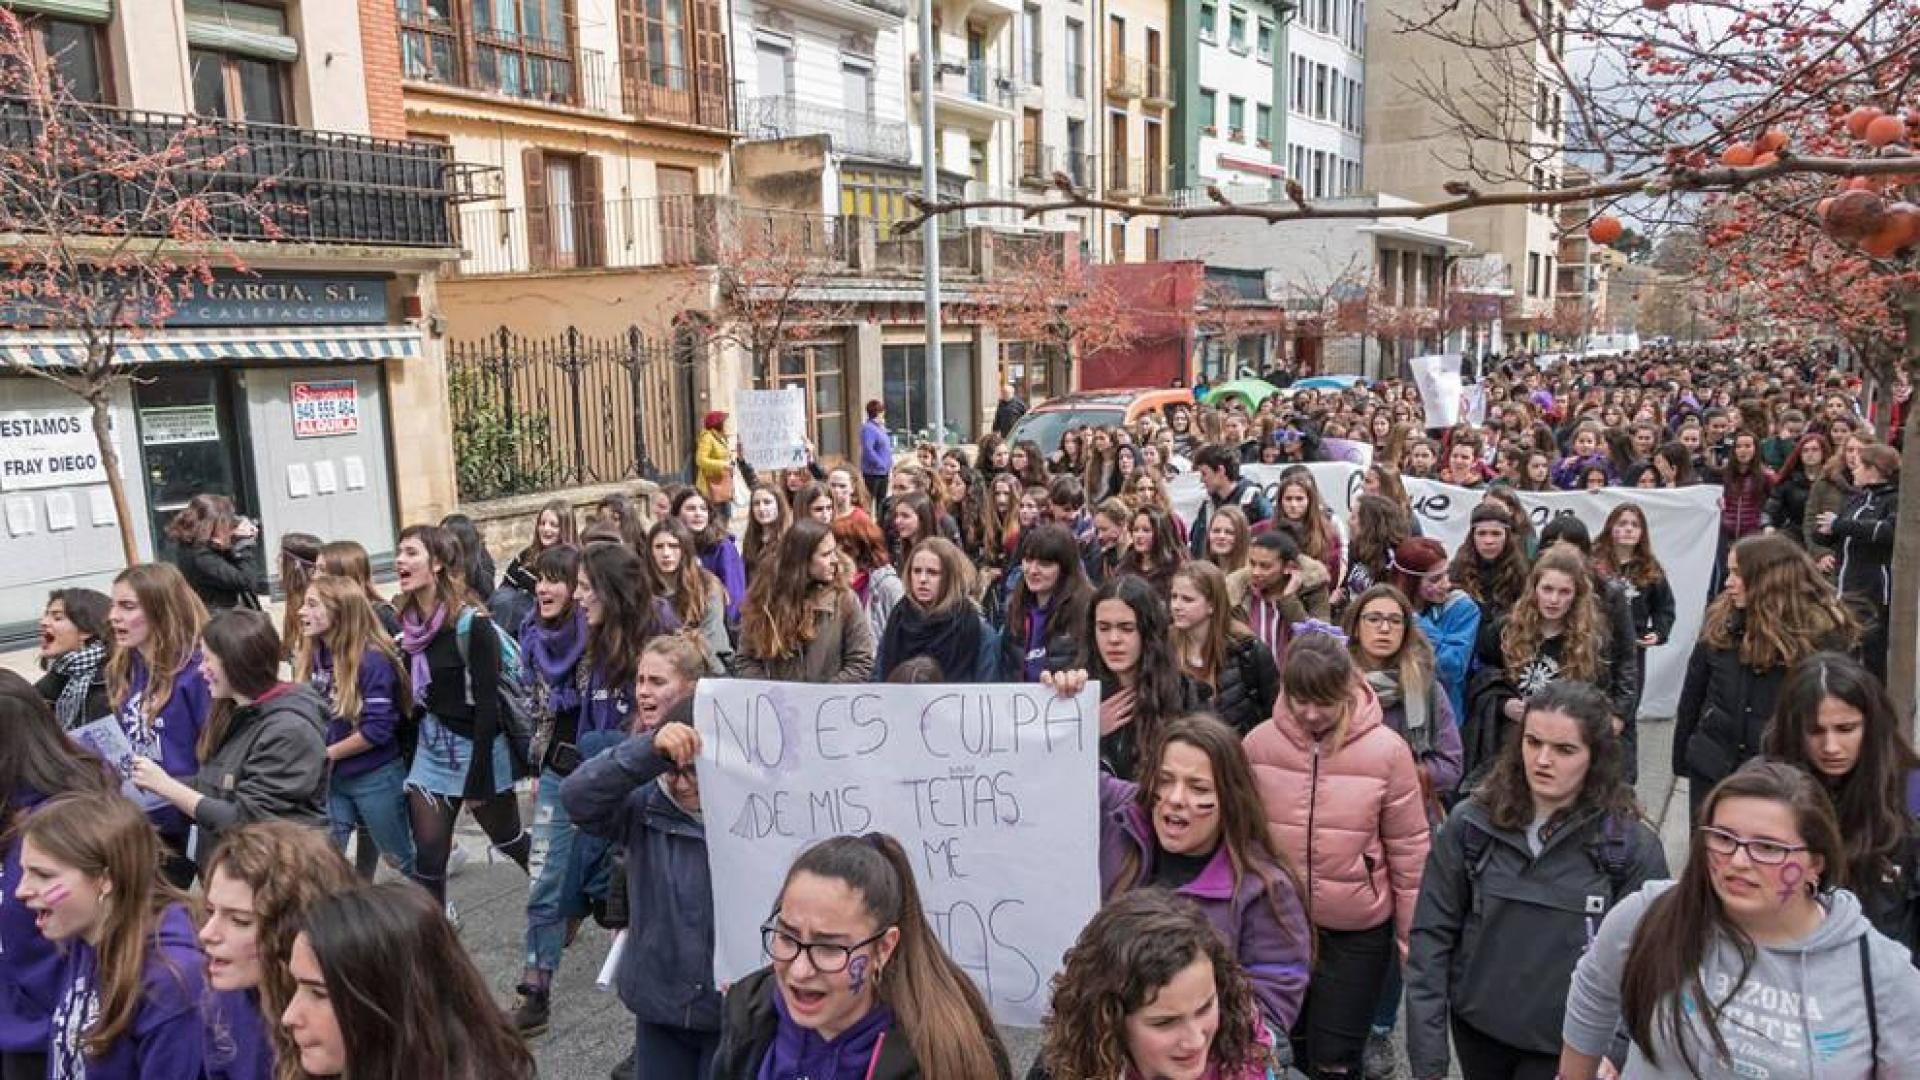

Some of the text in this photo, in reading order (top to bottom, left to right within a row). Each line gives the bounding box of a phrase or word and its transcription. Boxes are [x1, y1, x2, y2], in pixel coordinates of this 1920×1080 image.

[120, 282, 195, 299] JUN
[1, 416, 81, 437] ESTAMOS
[4, 454, 97, 476] FRAY DIEGO
[712, 693, 1083, 768] NO ES CULPA
[808, 786, 872, 836] MIS
[903, 771, 1022, 828] TETAS
[923, 838, 968, 880] ME
